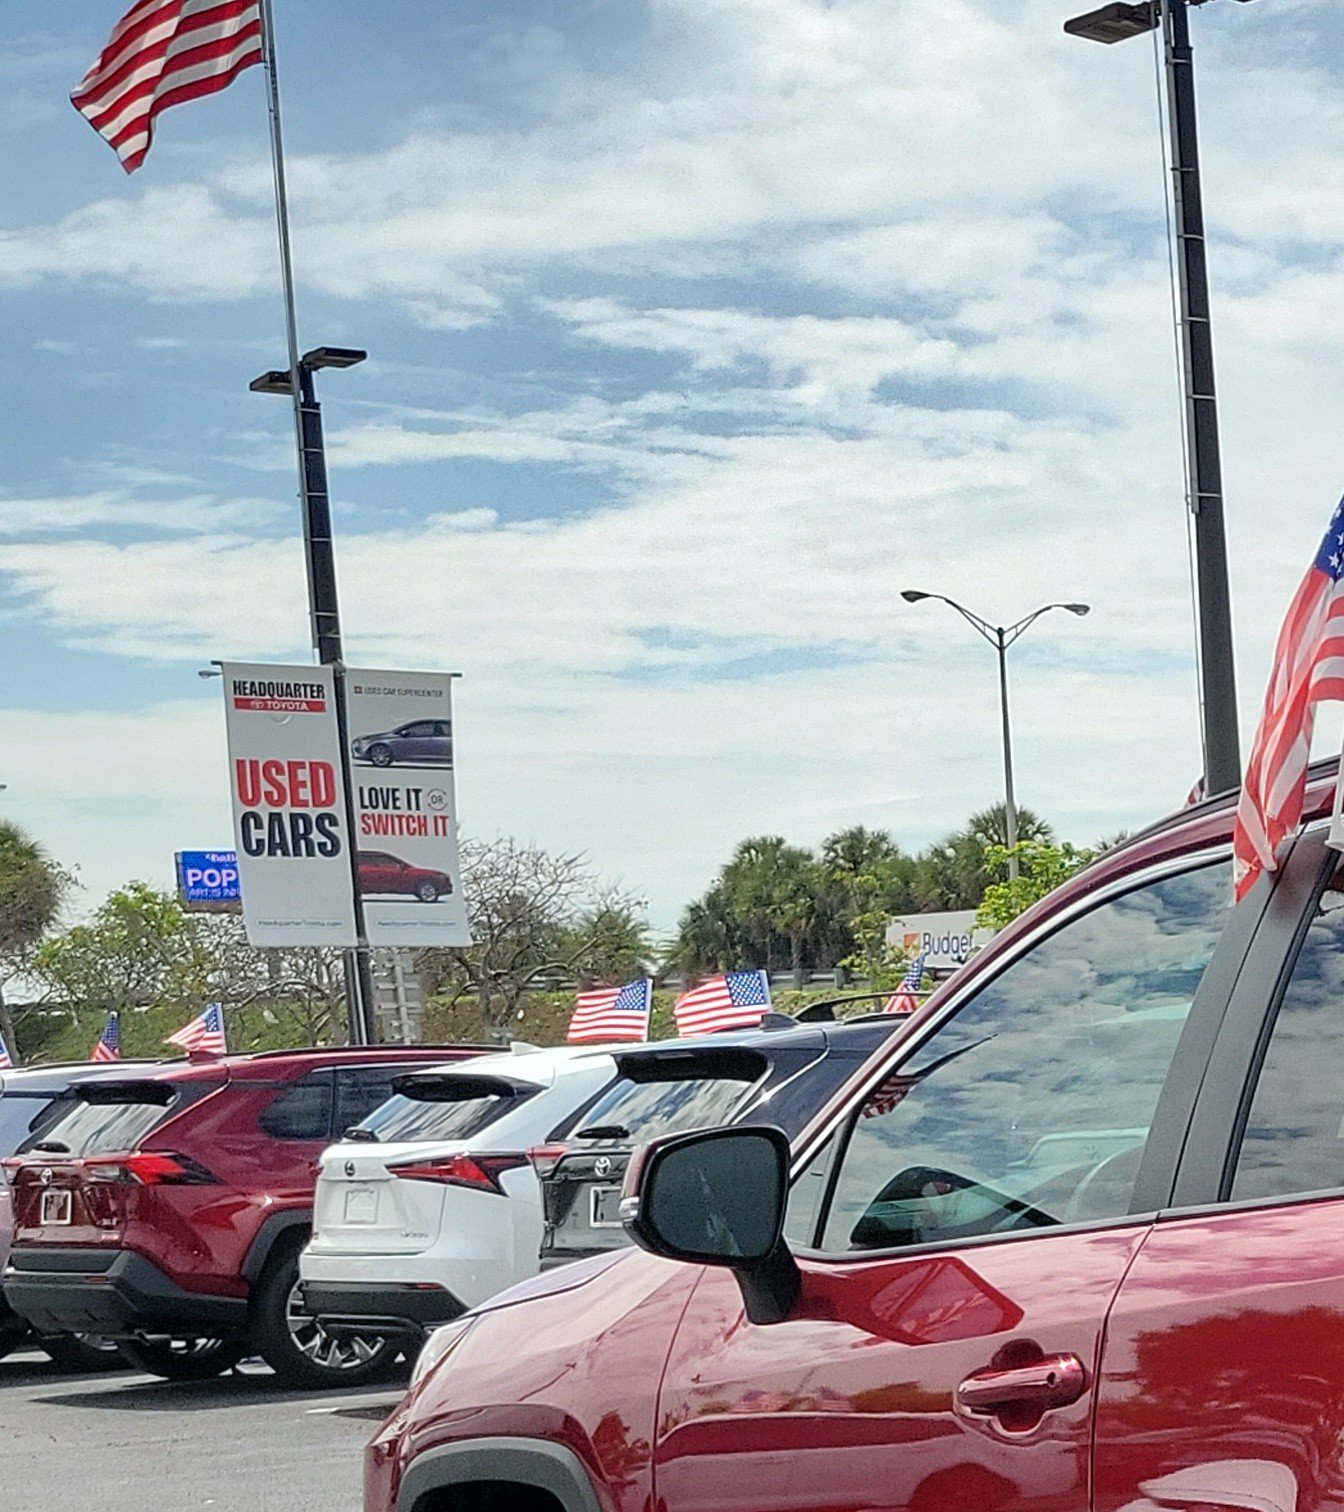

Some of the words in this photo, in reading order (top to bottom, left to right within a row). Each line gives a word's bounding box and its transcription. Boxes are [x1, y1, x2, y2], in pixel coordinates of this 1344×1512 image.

[233, 680, 325, 700] HEADQUARTER
[266, 700, 309, 711] TOYOTA
[235, 759, 336, 808] USED
[359, 786, 401, 810] LOVE
[406, 787, 423, 810] IT
[431, 793, 444, 805] OR
[241, 811, 341, 858] CARS
[361, 814, 428, 836] SWITCH
[433, 815, 449, 837] IT
